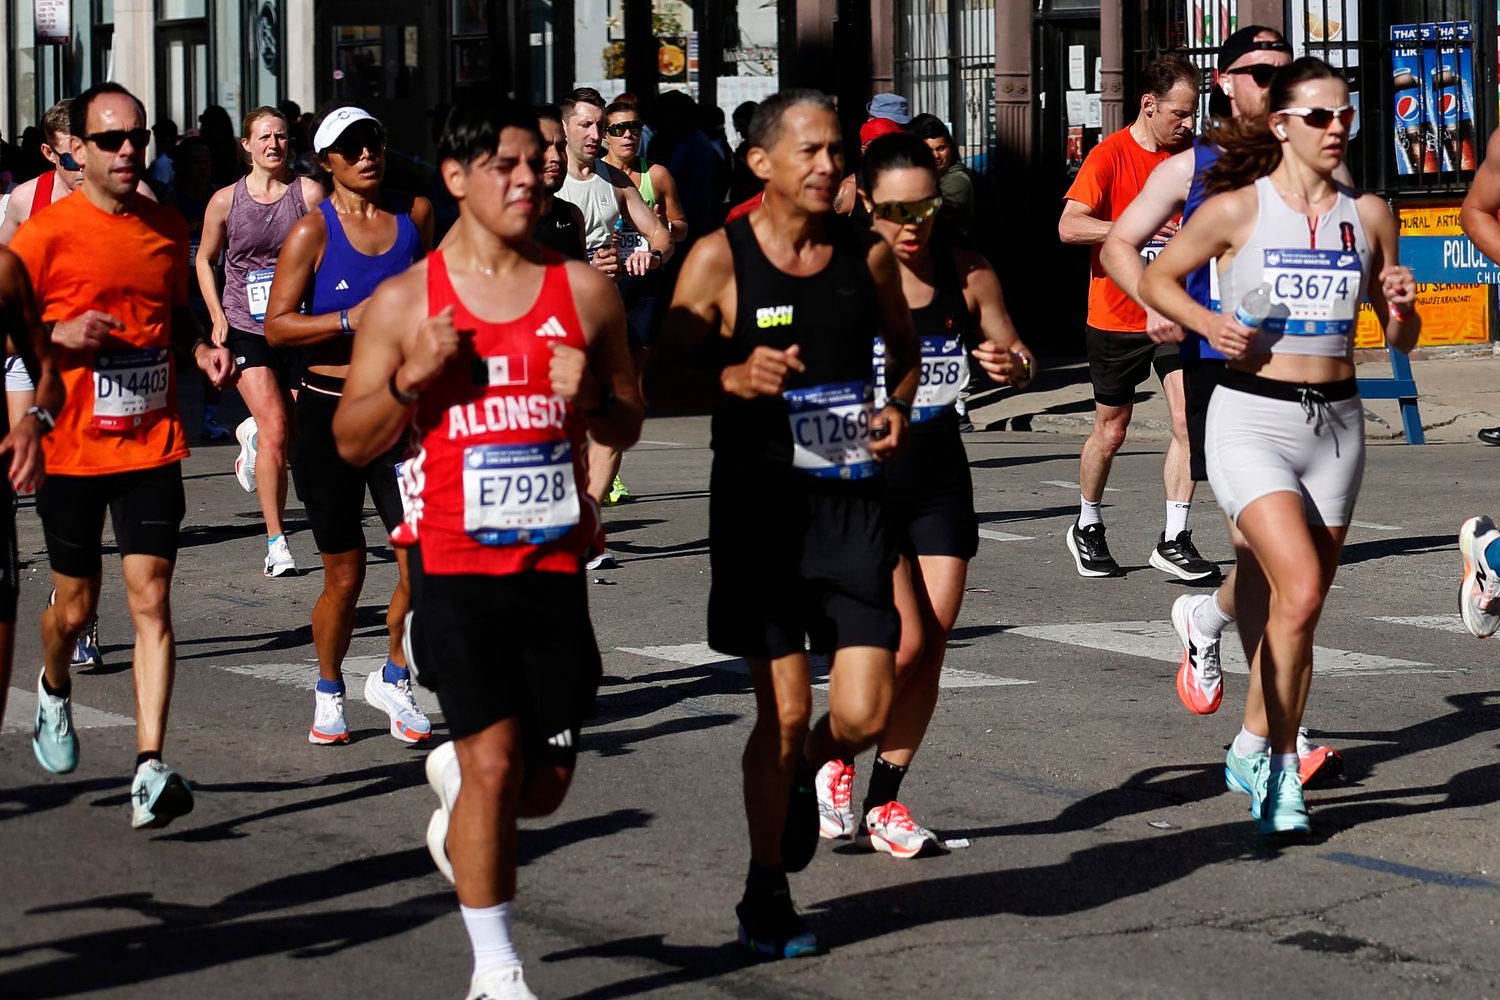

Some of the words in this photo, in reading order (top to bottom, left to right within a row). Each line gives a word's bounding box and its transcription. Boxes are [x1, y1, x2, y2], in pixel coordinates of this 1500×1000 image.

[1401, 48, 1424, 57] LIK
[1400, 216, 1430, 229] MURAL
[1437, 215, 1463, 228] ARTIS
[1274, 273, 1349, 301] C3674
[98, 368, 168, 398] D14403
[448, 394, 567, 440] ALONSO
[795, 407, 871, 447] C1269
[479, 470, 566, 506] E7928
